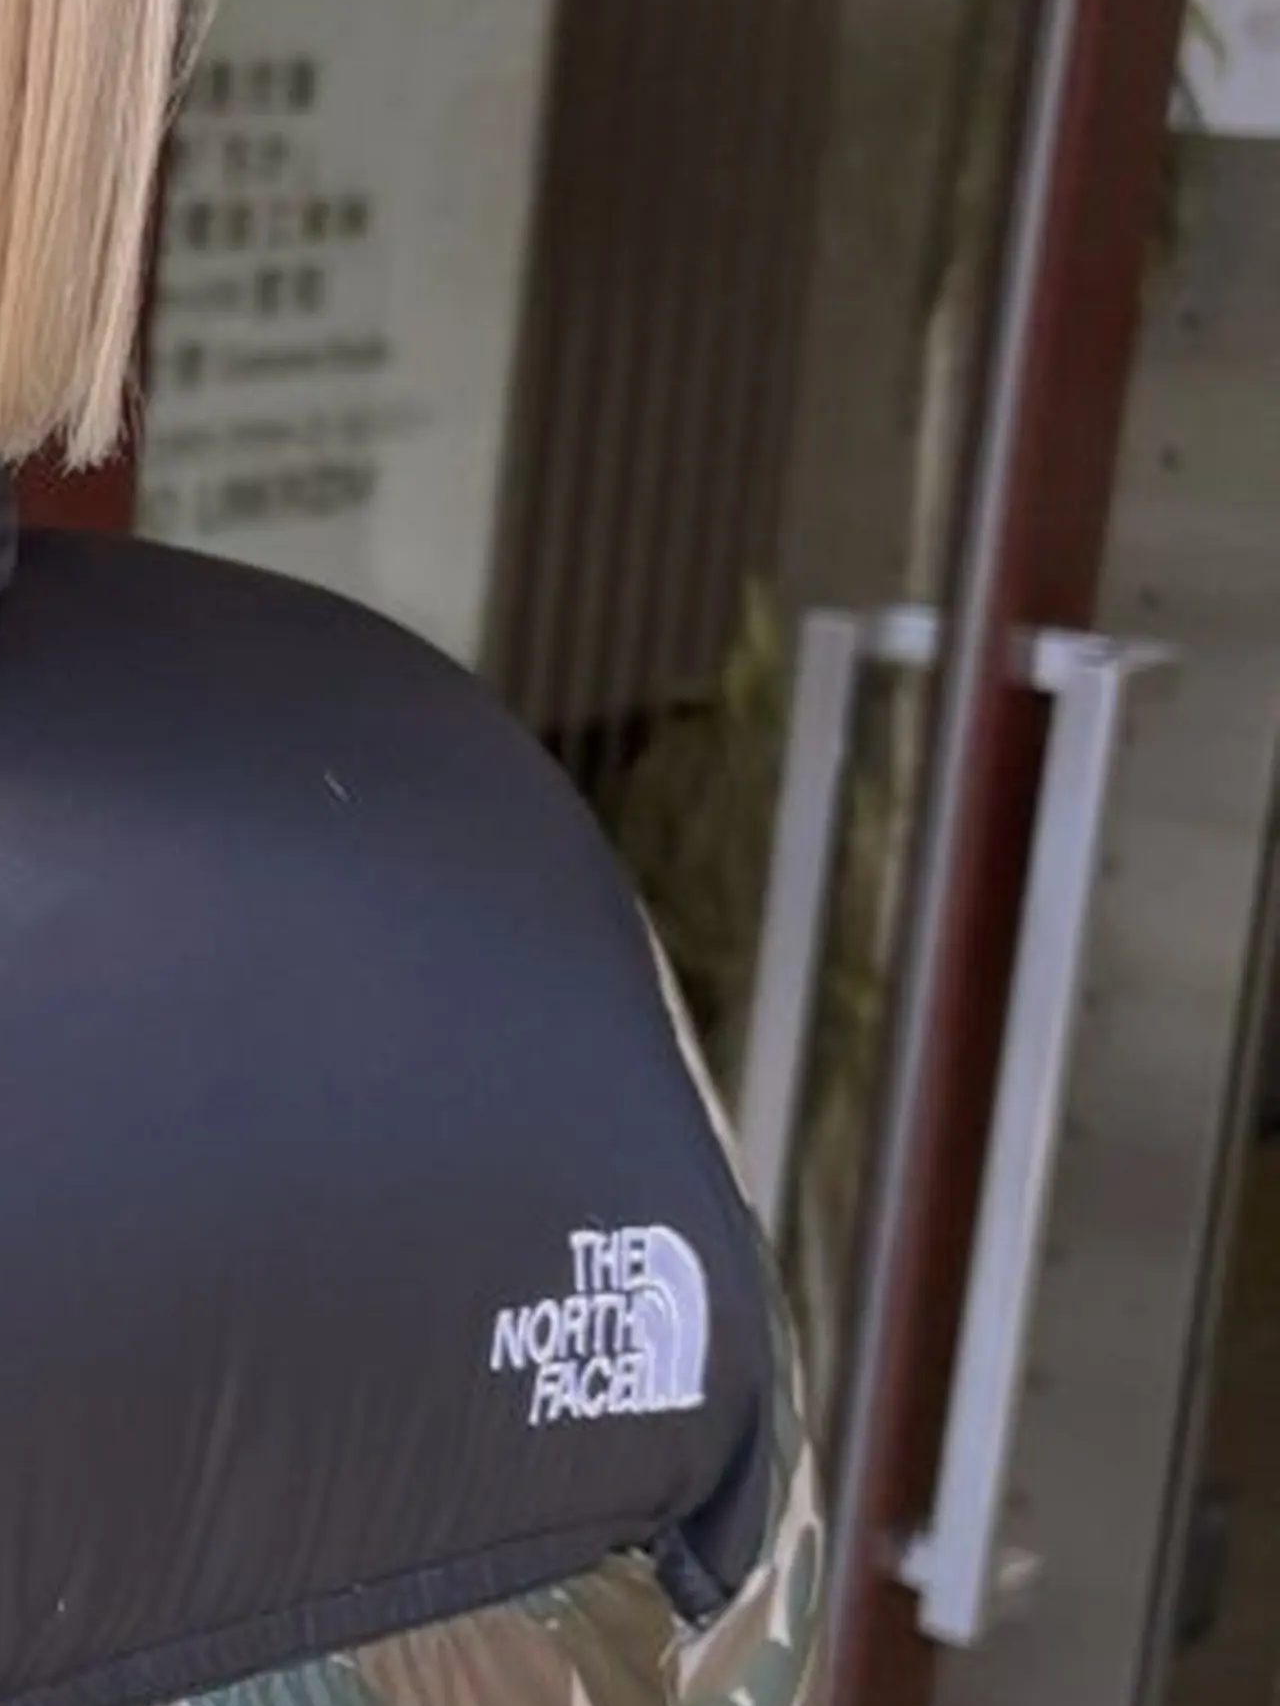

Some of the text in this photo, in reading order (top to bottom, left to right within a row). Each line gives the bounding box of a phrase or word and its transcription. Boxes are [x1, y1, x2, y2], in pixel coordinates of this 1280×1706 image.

[569, 1227, 649, 1293] THE
[490, 1292, 648, 1371] NORTH
[528, 1353, 648, 1426] FACE
